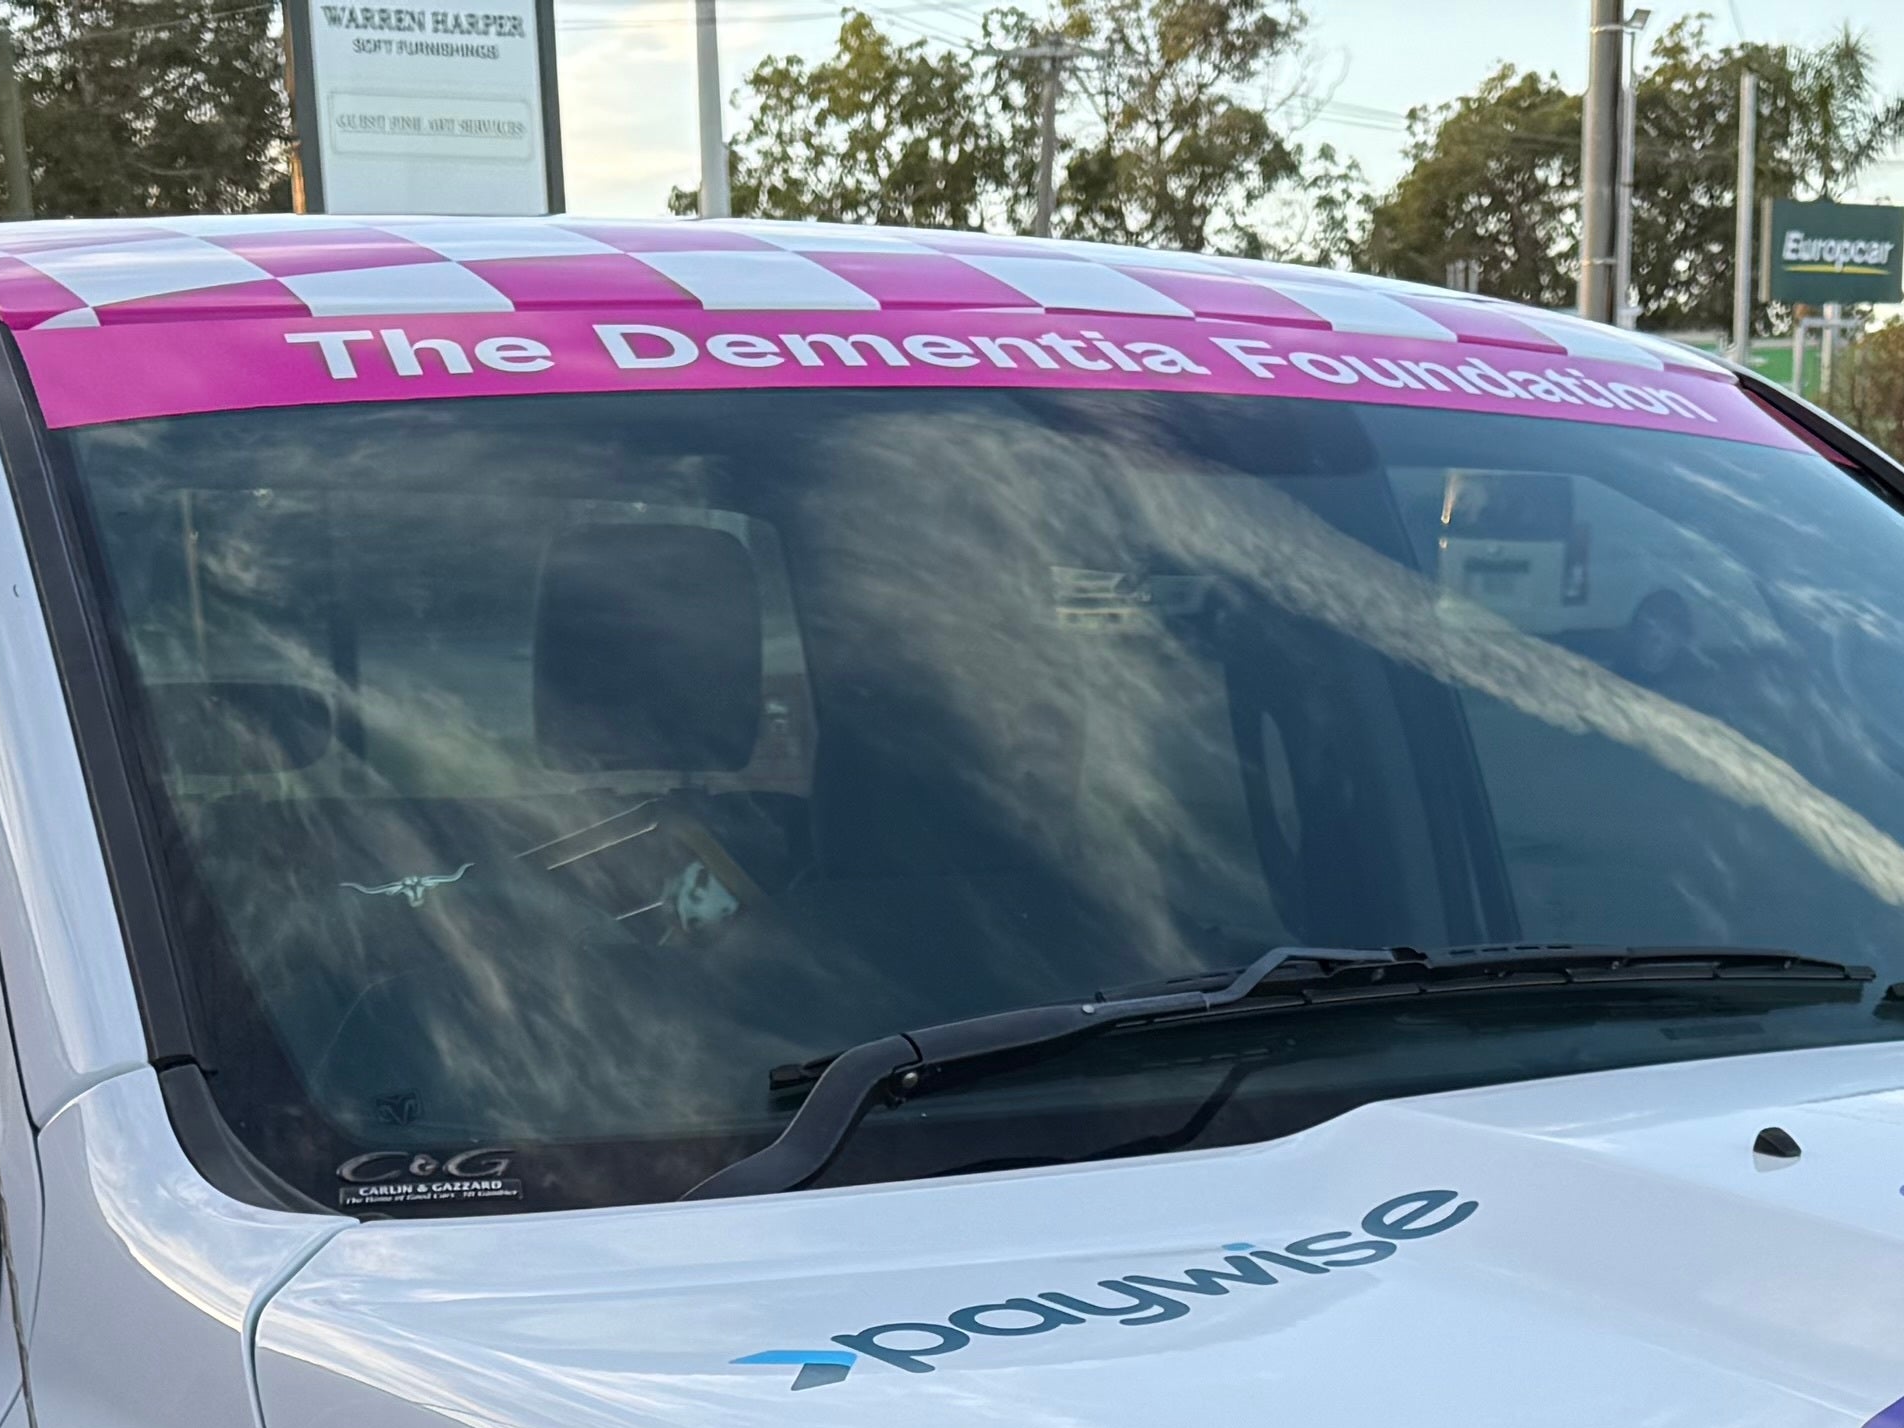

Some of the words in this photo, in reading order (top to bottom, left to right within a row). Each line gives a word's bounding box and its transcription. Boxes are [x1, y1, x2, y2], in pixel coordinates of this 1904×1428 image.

[321, 5, 425, 33] WARREN
[431, 11, 525, 38] HARPER
[352, 38, 393, 55] SOFT
[396, 40, 499, 59] FURNISHINGS
[1782, 230, 1895, 272] Europcar
[285, 329, 555, 379] The
[591, 324, 1212, 376] Dementia
[1208, 336, 1719, 423] Foundation
[359, 1183, 413, 1197] CARLIN
[416, 1182, 428, 1194] &
[431, 1180, 503, 1193] GAZZARD
[830, 1188, 1479, 1373] paywise
